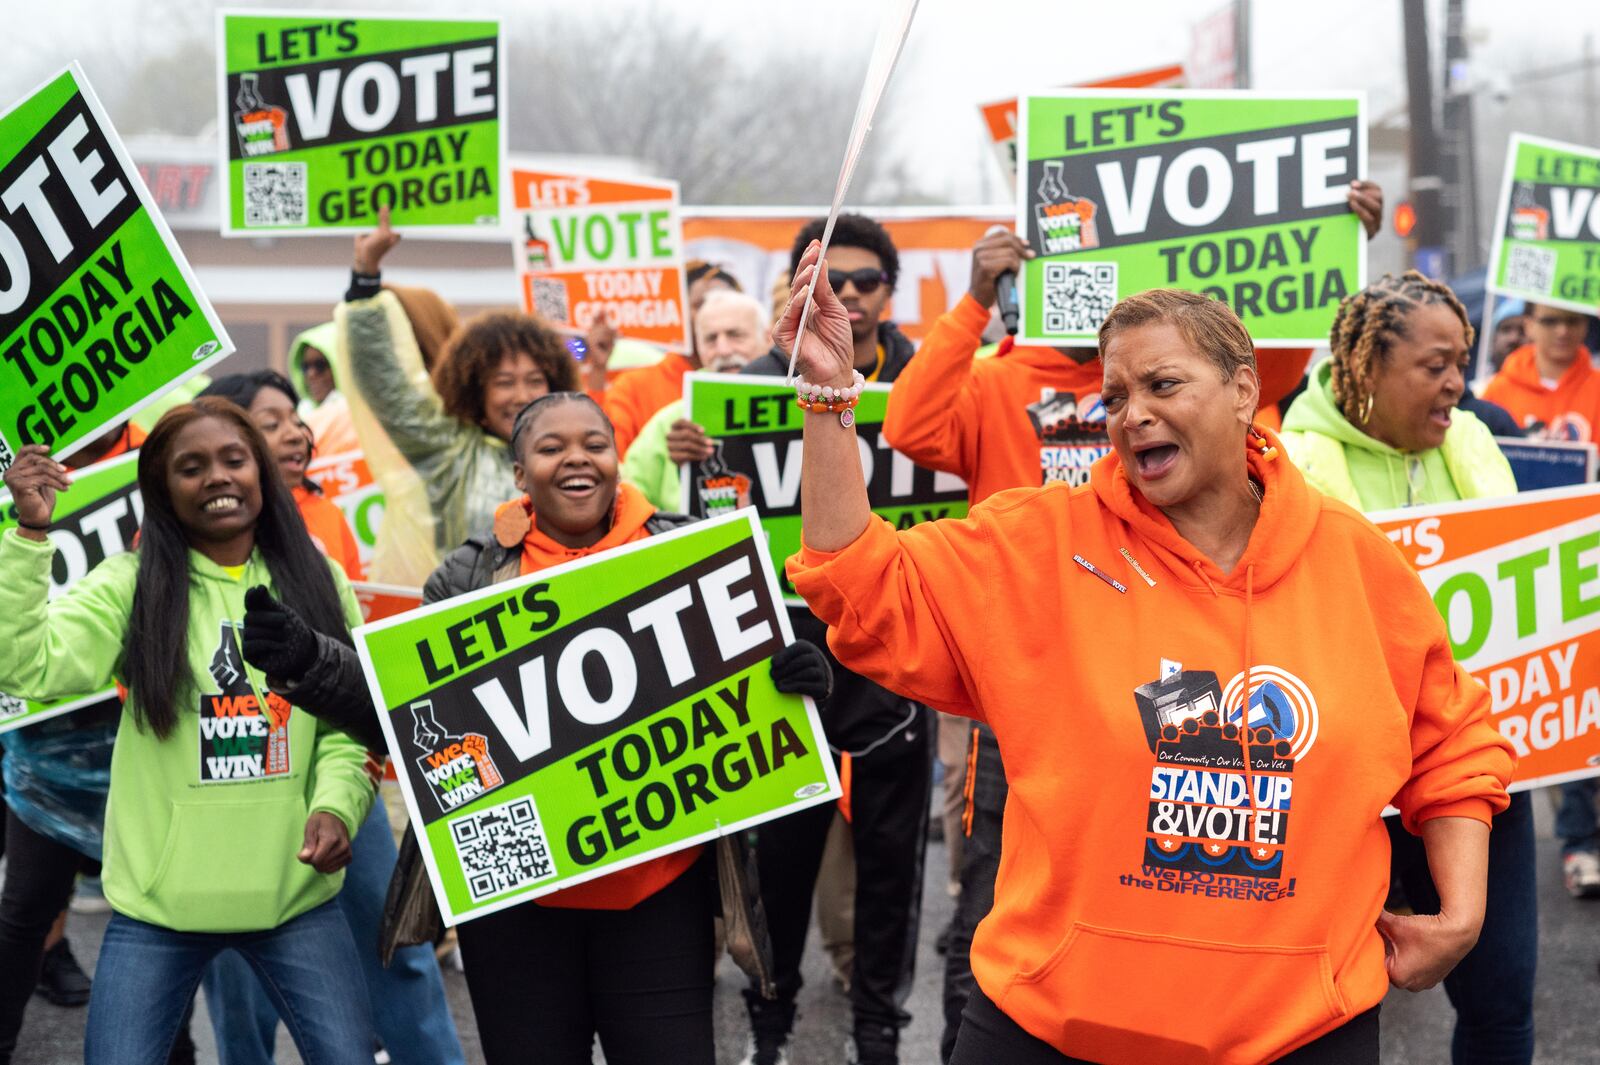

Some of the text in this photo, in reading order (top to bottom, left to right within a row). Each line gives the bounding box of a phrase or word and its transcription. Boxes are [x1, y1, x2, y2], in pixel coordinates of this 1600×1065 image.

[257, 21, 359, 64] LET'S
[286, 47, 496, 140] VOTE
[1065, 101, 1185, 150] LET'S
[340, 131, 470, 180] TODAY
[318, 167, 492, 224] GEORGIA
[528, 180, 591, 208] LET'S
[1095, 127, 1352, 237] VOTE
[550, 210, 673, 263] VOTE
[1158, 225, 1321, 283] TODAY
[583, 271, 663, 299] TODAY
[3, 240, 134, 388] TODAY
[574, 299, 682, 329] GEORGIA
[16, 277, 193, 447] GEORGIA
[724, 394, 797, 431] LET
[1433, 529, 1600, 662] OTE
[415, 583, 561, 686] LET'S
[472, 555, 774, 763] VOTE
[1473, 643, 1580, 715] DAY
[200, 715, 268, 740] VOTE
[211, 694, 260, 719] we
[575, 676, 752, 800] TODAY
[1159, 750, 1173, 761] Our
[1174, 752, 1211, 767] Community
[1216, 756, 1231, 766] Our
[1256, 760, 1270, 769] Our
[1271, 760, 1288, 769] Vote
[425, 753, 476, 786] VOTE
[565, 716, 809, 866] GEORGIA
[1152, 801, 1282, 845] &VOTE!
[1118, 872, 1297, 903] the DIFFERENCE!
[1141, 863, 1280, 892] We DO make
